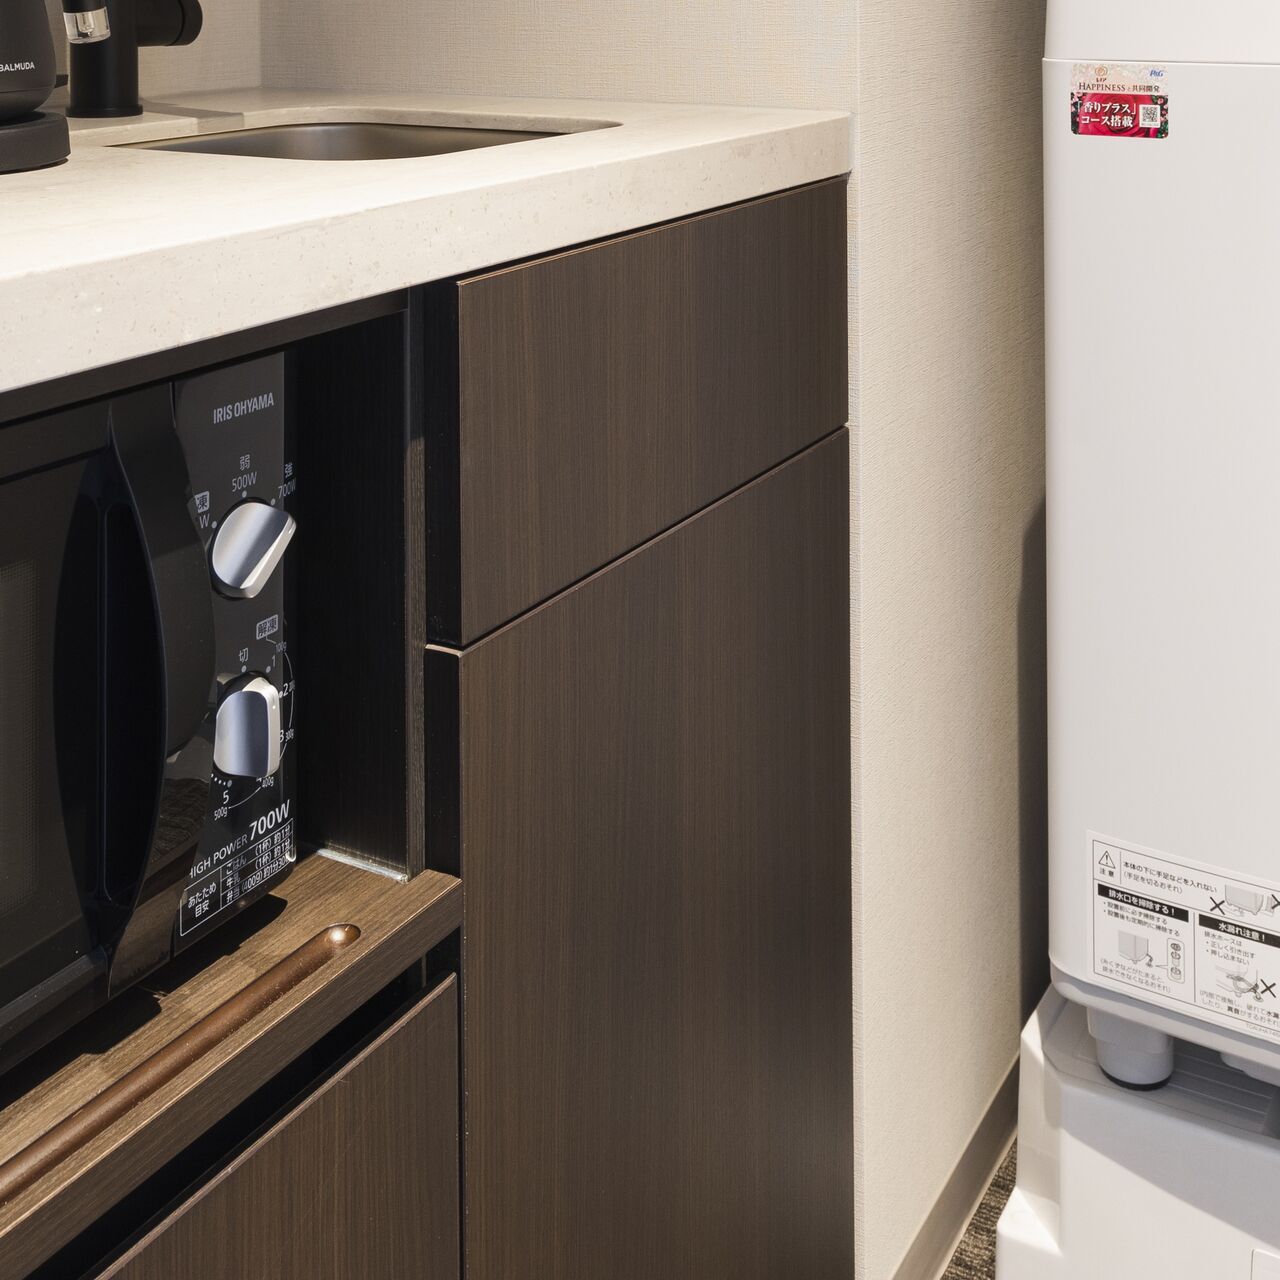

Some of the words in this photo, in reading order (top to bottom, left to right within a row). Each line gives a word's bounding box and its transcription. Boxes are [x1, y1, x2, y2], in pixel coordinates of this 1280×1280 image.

[1078, 82, 1126, 93] HAPPINESS
[1081, 115, 1134, 128] コース搭載
[213, 405, 232, 424] IRIS
[234, 392, 274, 417] OHYAMA
[240, 454, 250, 470] 弱
[232, 472, 257, 492] 500W
[278, 479, 296, 499] 700W
[258, 617, 277, 638] 解凍
[239, 648, 249, 662] 切
[283, 683, 289, 697] 2
[262, 776, 274, 788] 400g
[223, 789, 229, 805] 5
[214, 806, 228, 821] 500g
[213, 834, 248, 864] POWER
[249, 799, 290, 841] 700W
[226, 856, 247, 875] ごはん
[1099, 868, 1114, 877] 注意
[226, 873, 240, 888] 牛乳
[1123, 861, 1217, 894] 本体の下に手足などを入れない
[188, 882, 217, 909] あたため
[226, 888, 240, 904] 弁当
[1108, 889, 1175, 916] 排水口を掃除する！
[195, 900, 210, 918] 目安
[1218, 922, 1265, 942] 水漏れ注意！
